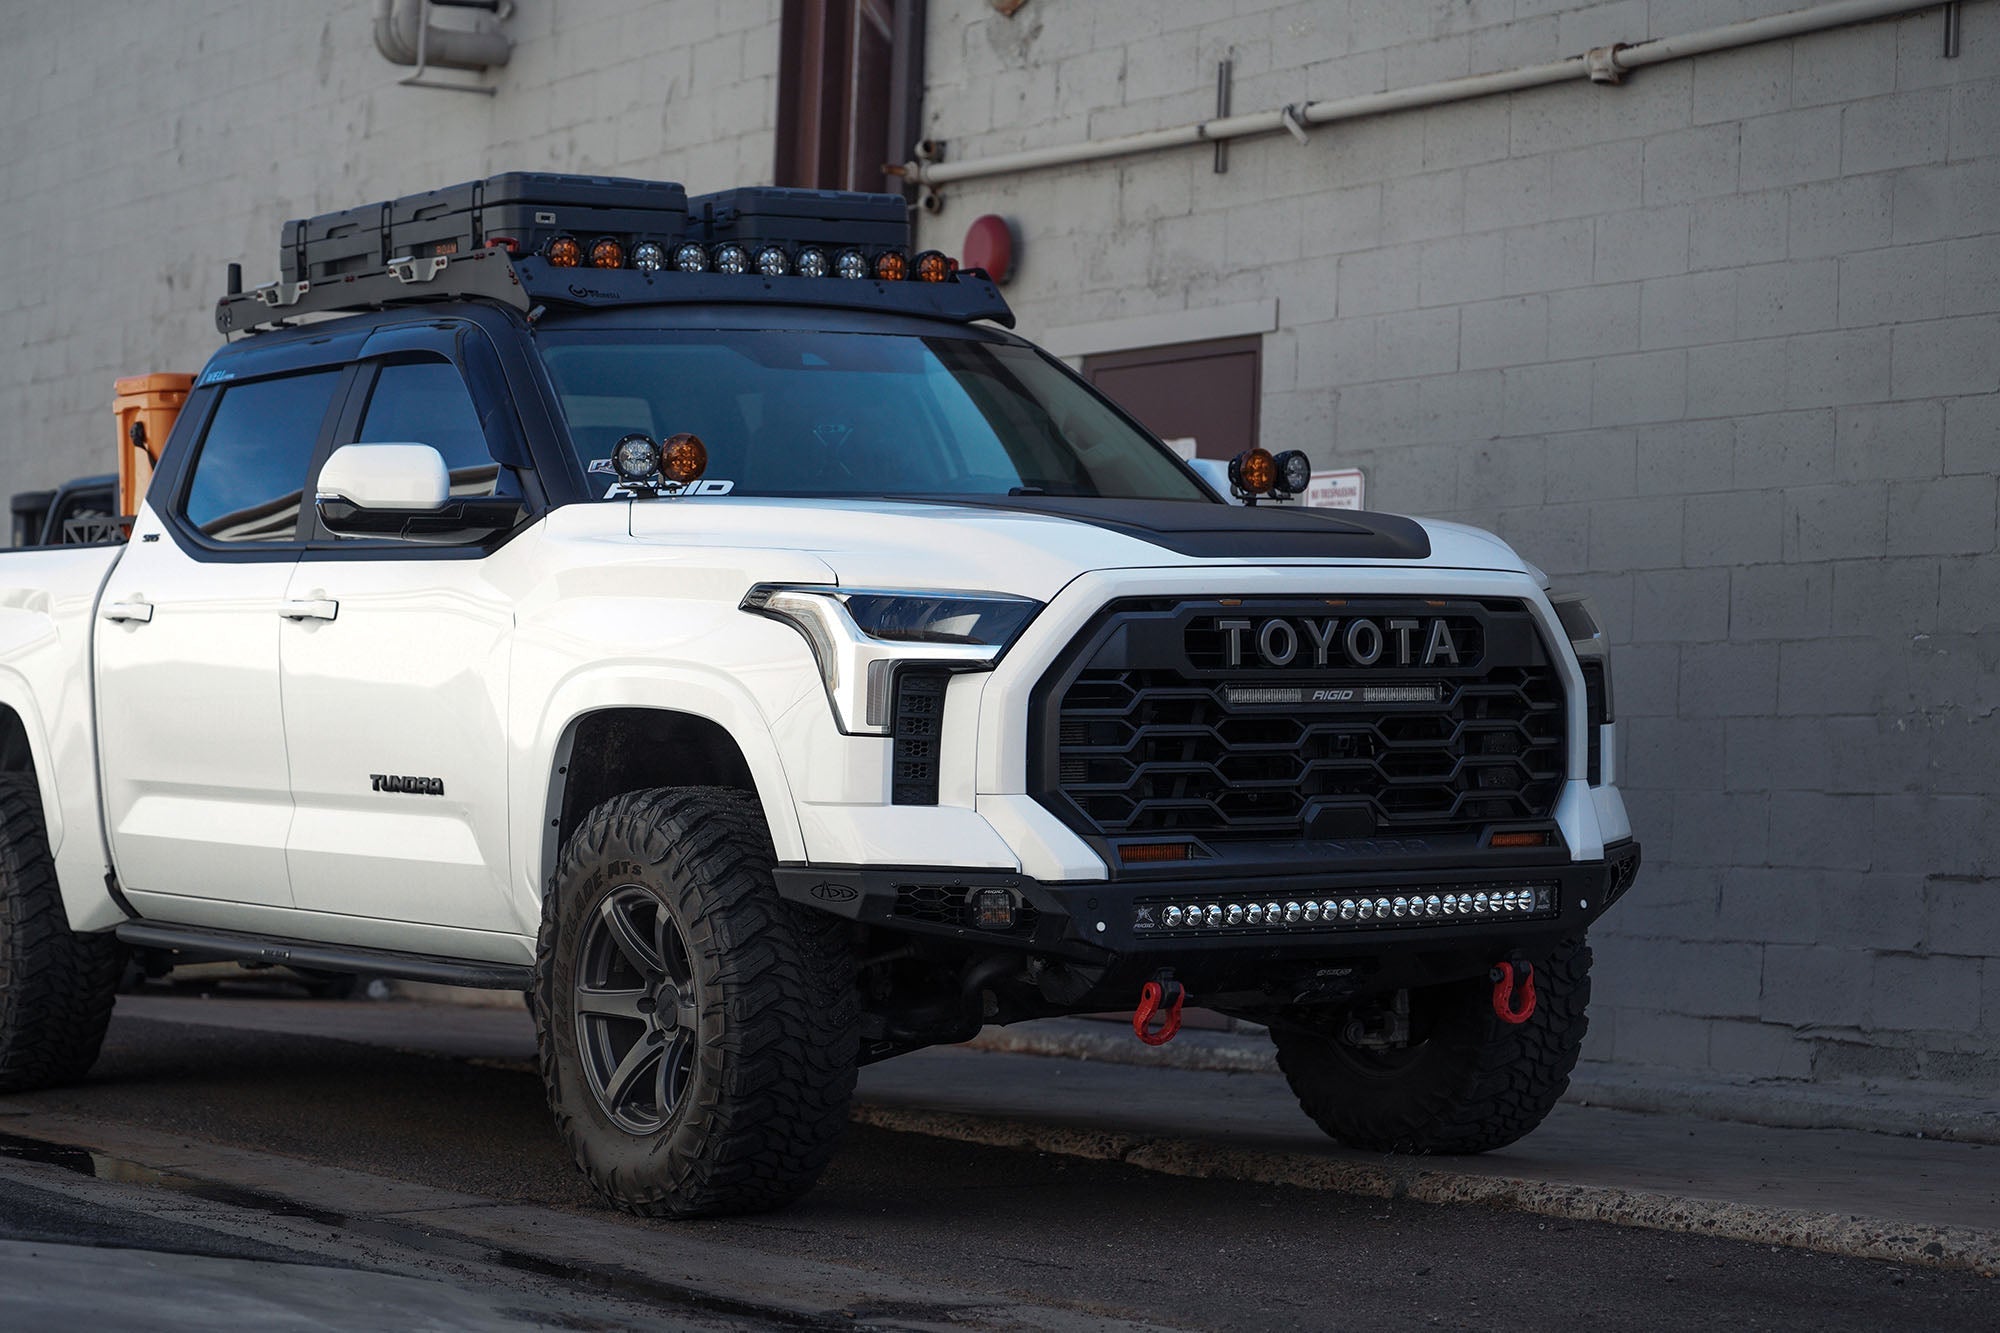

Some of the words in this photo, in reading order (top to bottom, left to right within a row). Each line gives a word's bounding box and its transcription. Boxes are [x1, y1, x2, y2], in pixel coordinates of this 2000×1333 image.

[1216, 619, 1459, 667] TOYOTA
[1312, 690, 1353, 701] RIGID
[370, 774, 445, 796] TUNDRA
